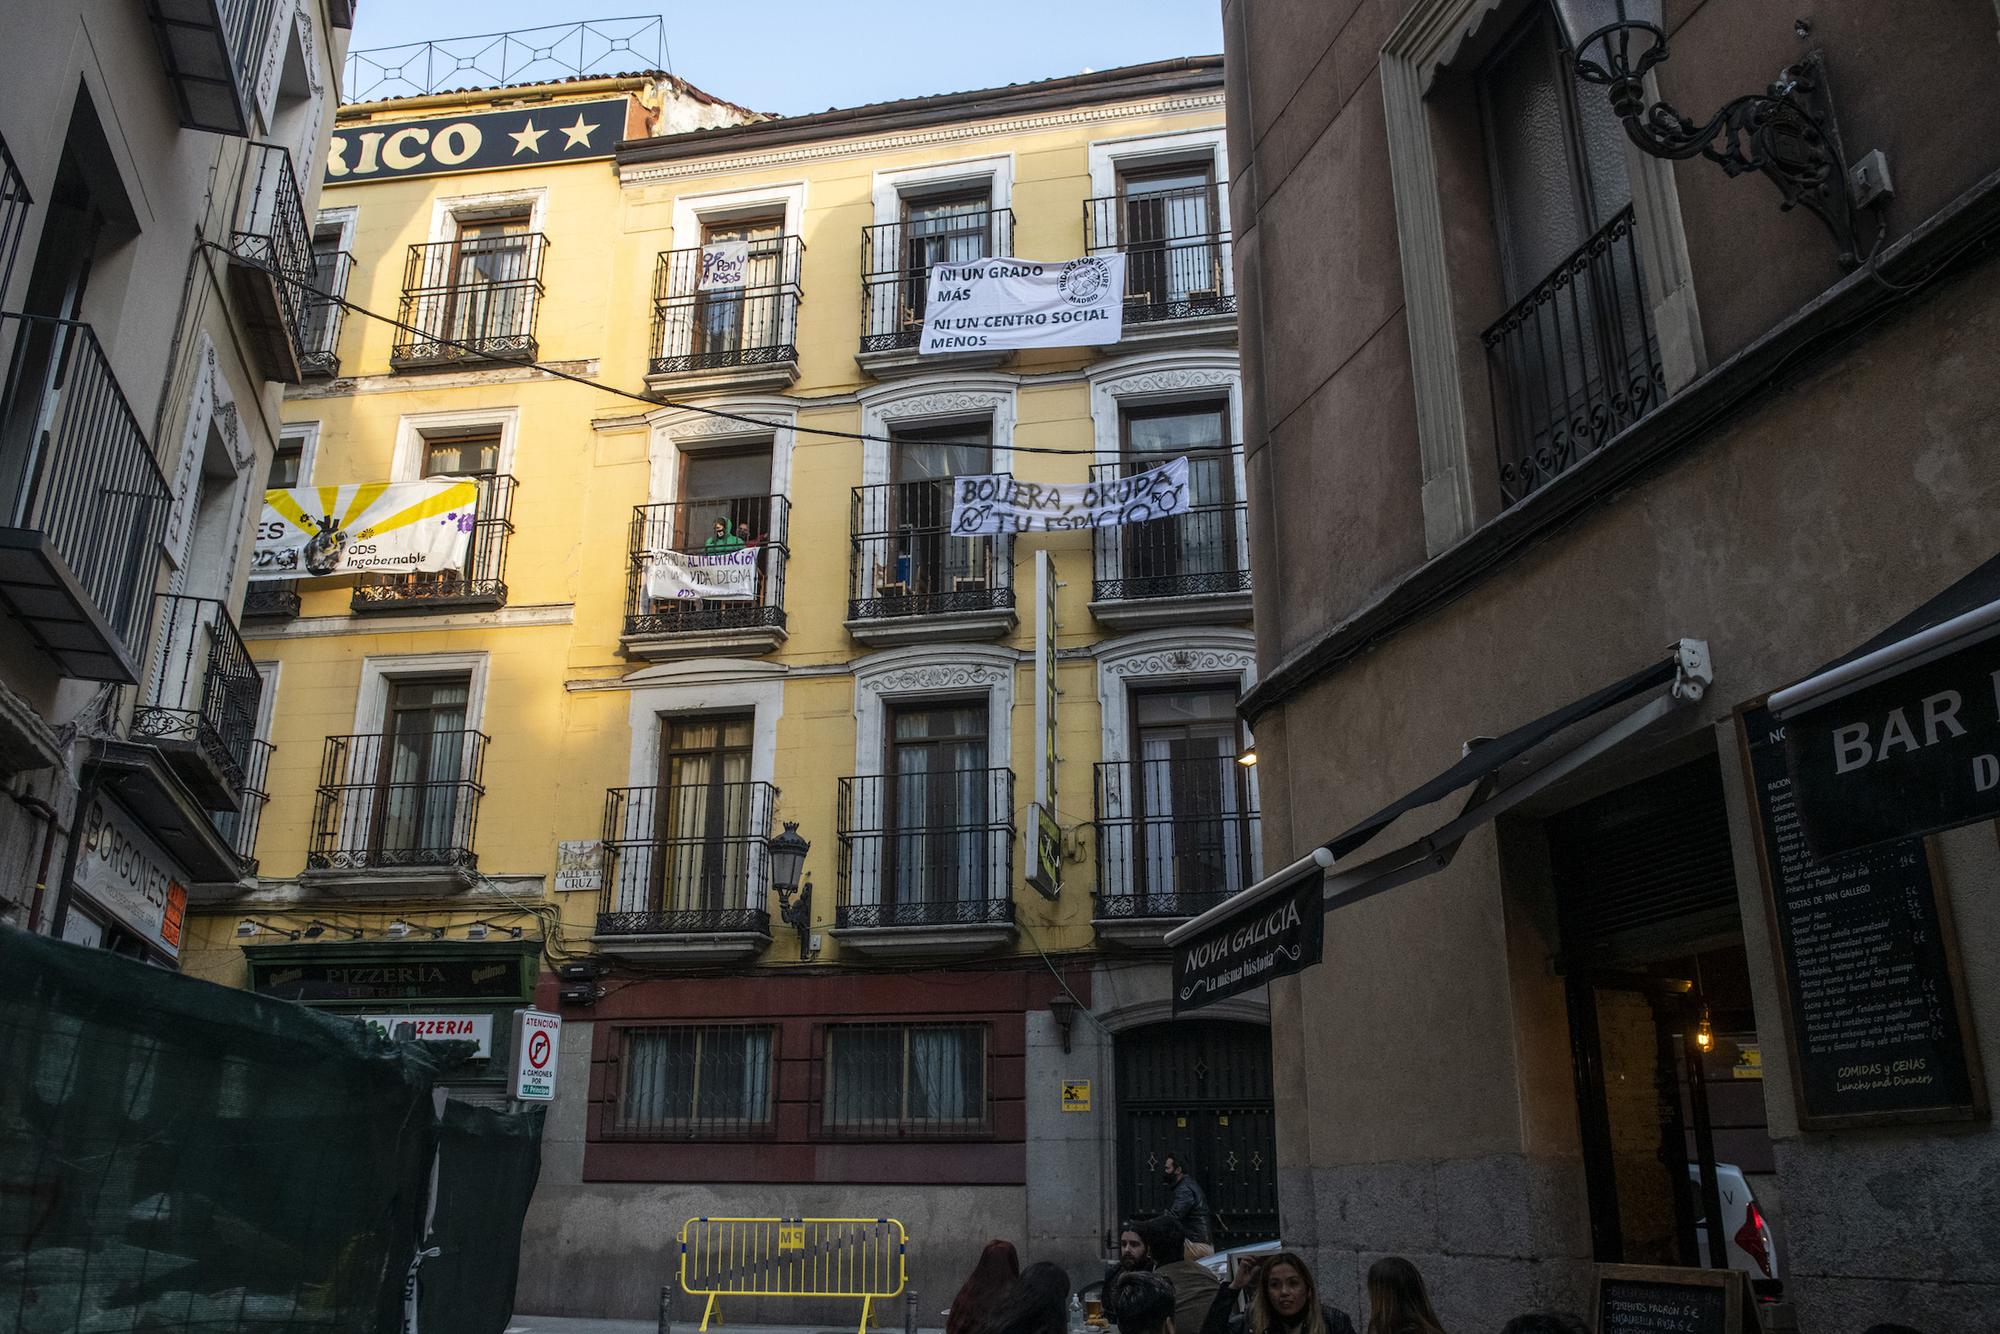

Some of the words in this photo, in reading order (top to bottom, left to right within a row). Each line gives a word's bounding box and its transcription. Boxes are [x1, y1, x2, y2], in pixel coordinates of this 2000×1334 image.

[939, 269, 956, 282] NI
[962, 267, 985, 281] UN
[988, 265, 1044, 279] GRADO
[1059, 261, 1077, 292] FRIDAYS
[1077, 257, 1095, 265] FOR
[1095, 261, 1109, 288] FUTURE
[937, 287, 971, 302] MÁS
[1068, 293, 1098, 304] MADRID
[933, 318, 951, 330] NI
[956, 317, 979, 329] UN
[983, 313, 1047, 328] CENTRO
[1051, 309, 1109, 324] SOCIAL
[930, 335, 987, 349] MENOS
[992, 511, 1031, 534] TU
[348, 544, 377, 554] ODS
[347, 552, 426, 569] Ingobernable
[1832, 690, 1967, 775] BAR
[556, 870, 581, 879] CALLE
[564, 878, 593, 889] CRUZ
[1788, 898, 1811, 910] TOSTAS
[1813, 895, 1823, 904] DE
[1825, 891, 1838, 901] PAN
[1840, 884, 1871, 897] GALLEGO
[1184, 933, 1229, 974] NOVA
[1232, 899, 1301, 953] GALICIA
[326, 964, 446, 985] PIZZERÍA
[1206, 976, 1216, 992] La
[1217, 965, 1243, 988] misma
[1243, 950, 1274, 977] historia
[401, 1021, 473, 1034] ZZERIA
[525, 1017, 559, 1029] ATENCIÓN
[527, 1069, 553, 1078] CAMIONES
[1837, 1062, 1882, 1079] COMIDAS
[1884, 1065, 1890, 1074] y
[1892, 1057, 1926, 1072] CENAS
[531, 1077, 542, 1085] POR
[1871, 1076, 1893, 1089] and
[1893, 1071, 1934, 1089] Dinners
